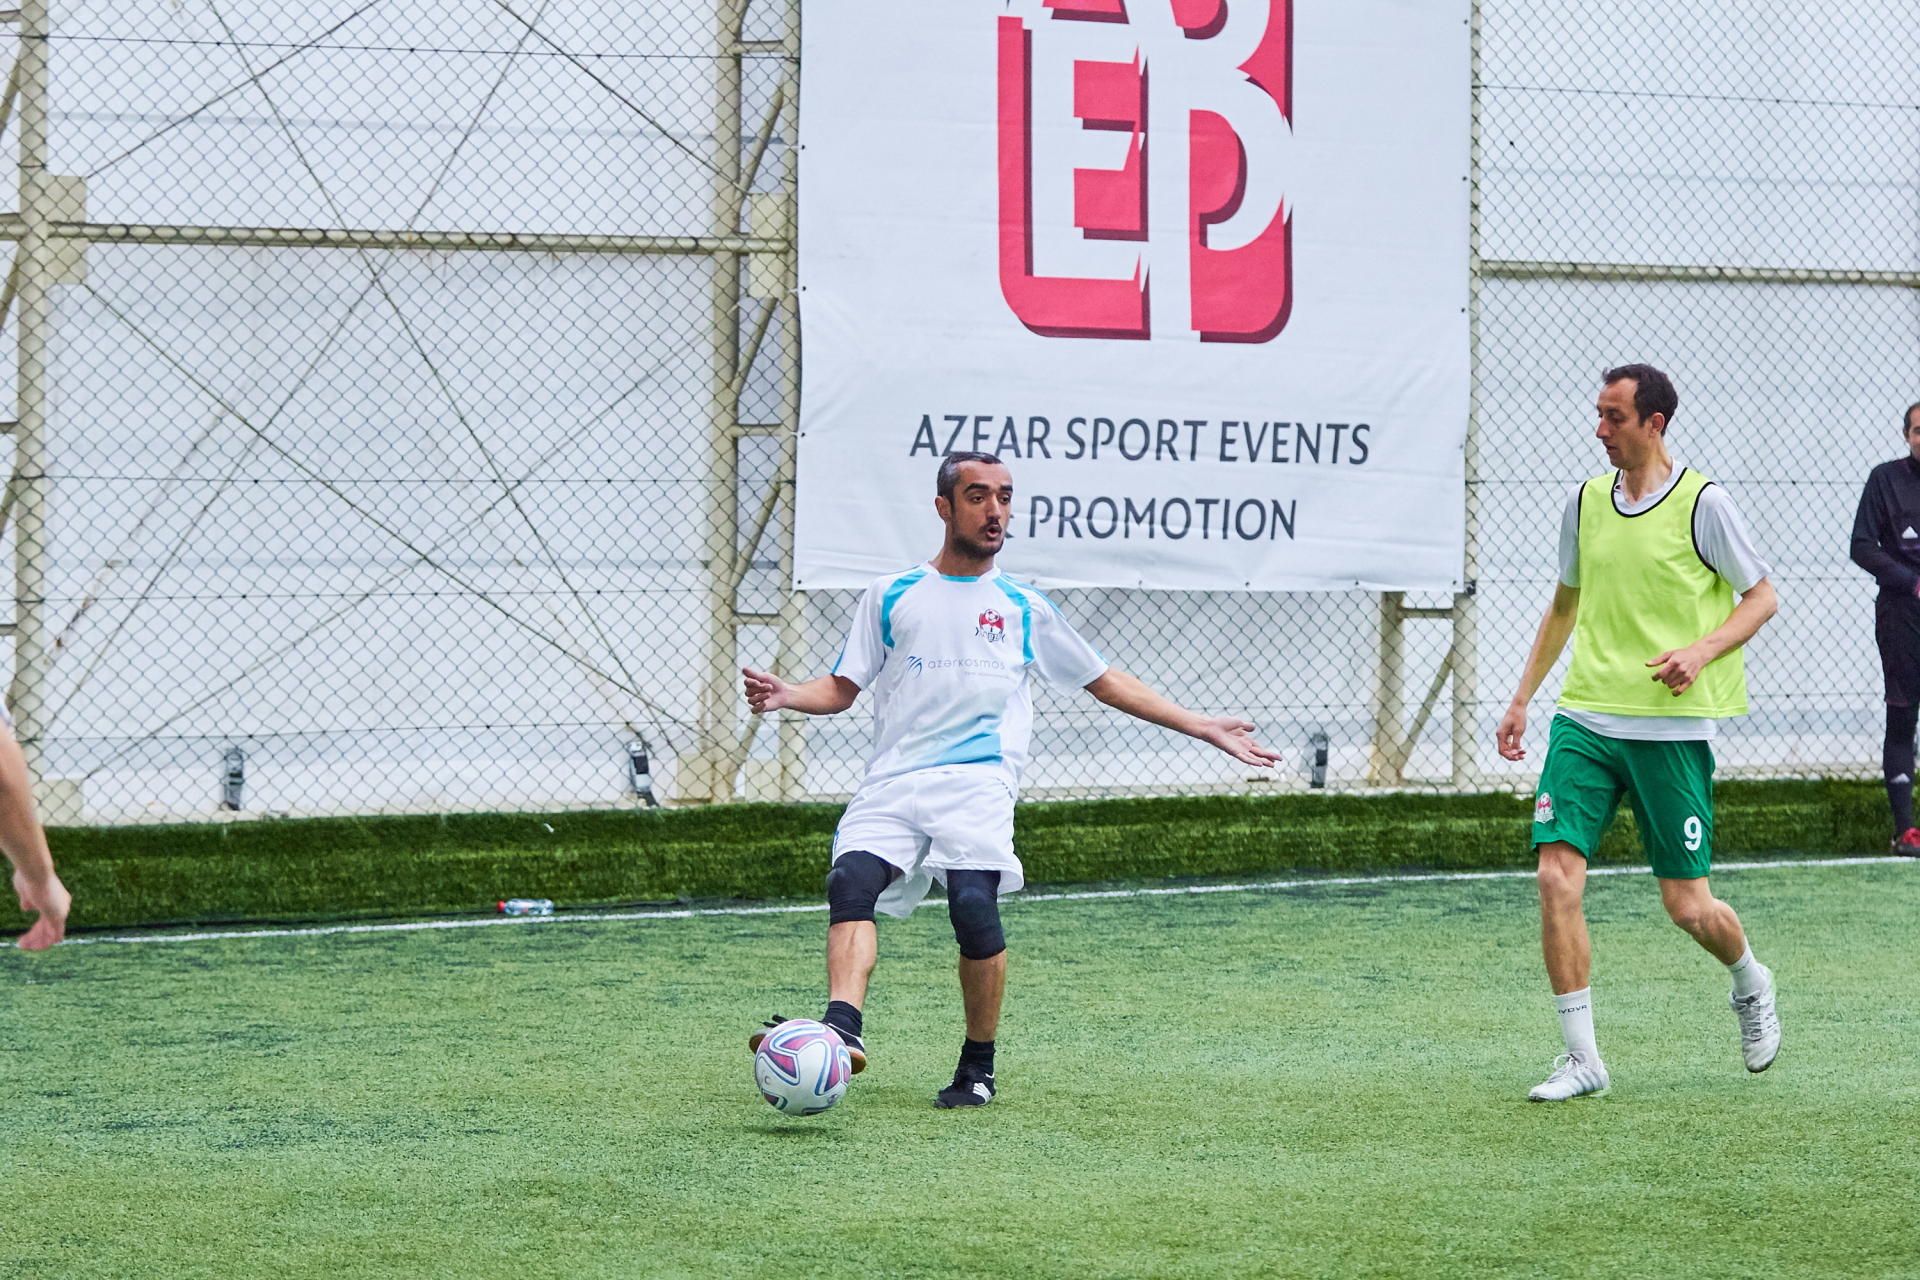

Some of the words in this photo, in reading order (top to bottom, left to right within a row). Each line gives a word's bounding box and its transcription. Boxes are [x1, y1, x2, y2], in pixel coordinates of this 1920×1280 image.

[1064, 416, 1208, 461] SPORT
[1219, 420, 1370, 465] EVENTS
[1028, 495, 1296, 541] PROMOTION
[1683, 816, 1702, 850] 9
